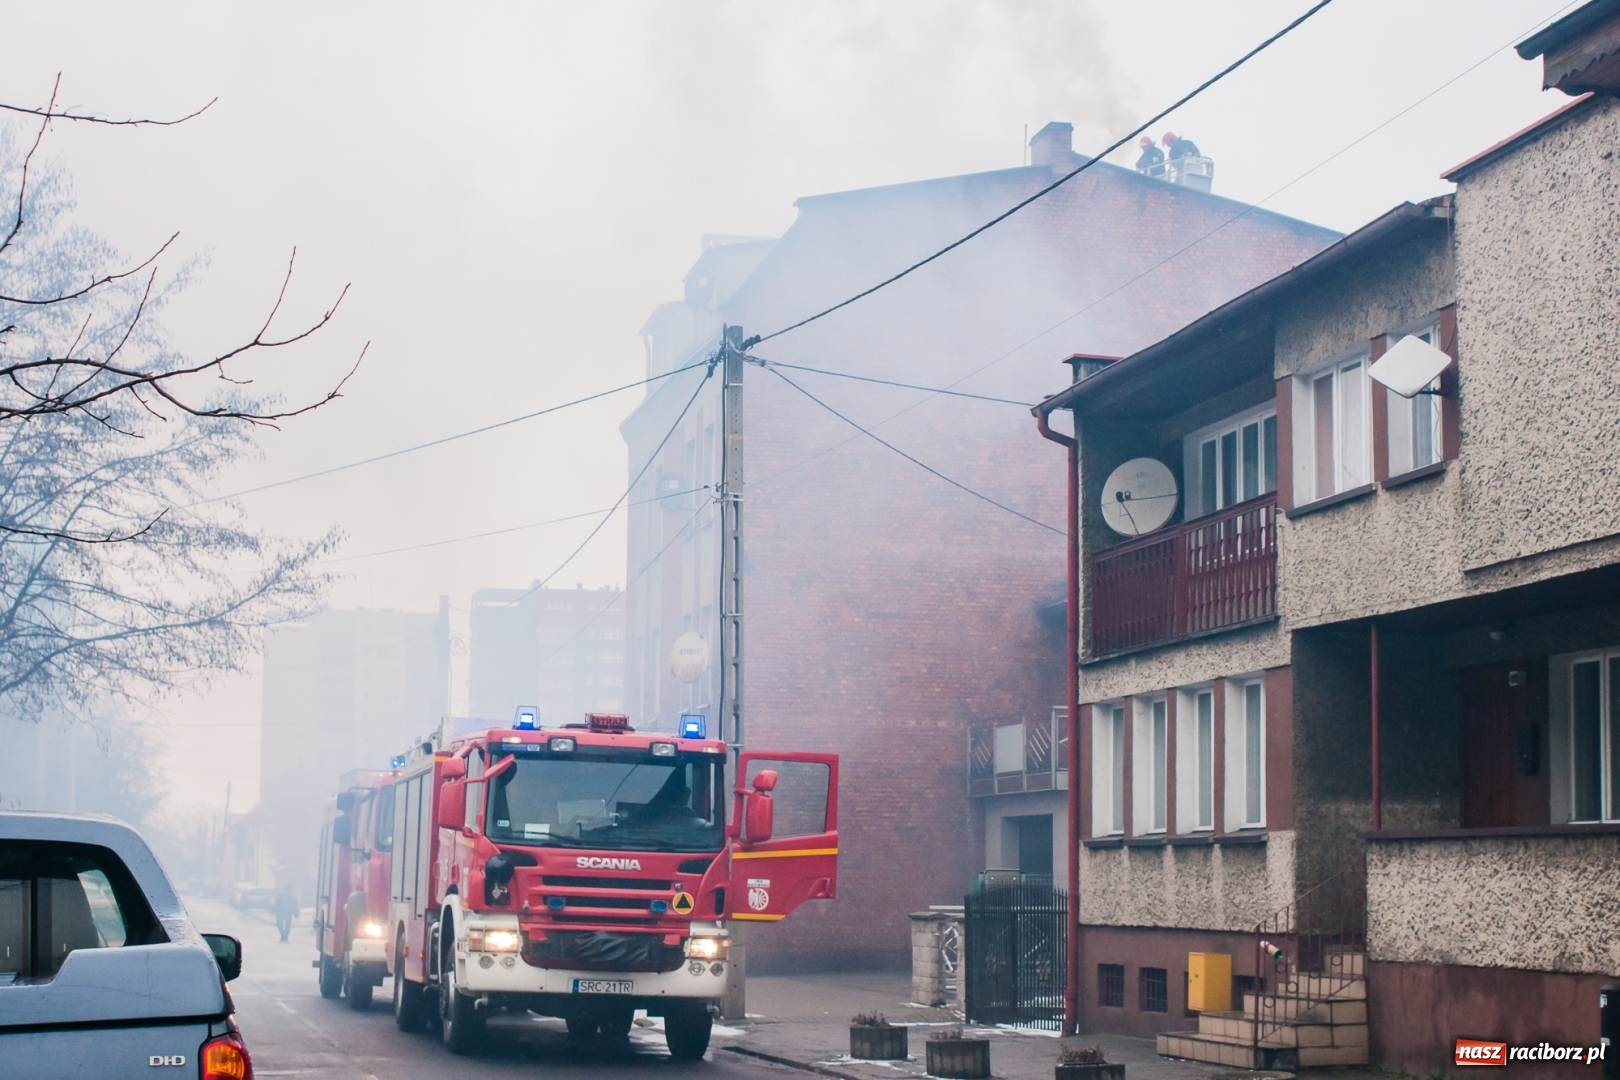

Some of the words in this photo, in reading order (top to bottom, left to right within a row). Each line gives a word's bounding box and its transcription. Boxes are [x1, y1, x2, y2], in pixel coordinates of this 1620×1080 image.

[576, 856, 642, 871] SCANIA
[580, 981, 602, 992] SRC
[605, 982, 631, 993] 21TR
